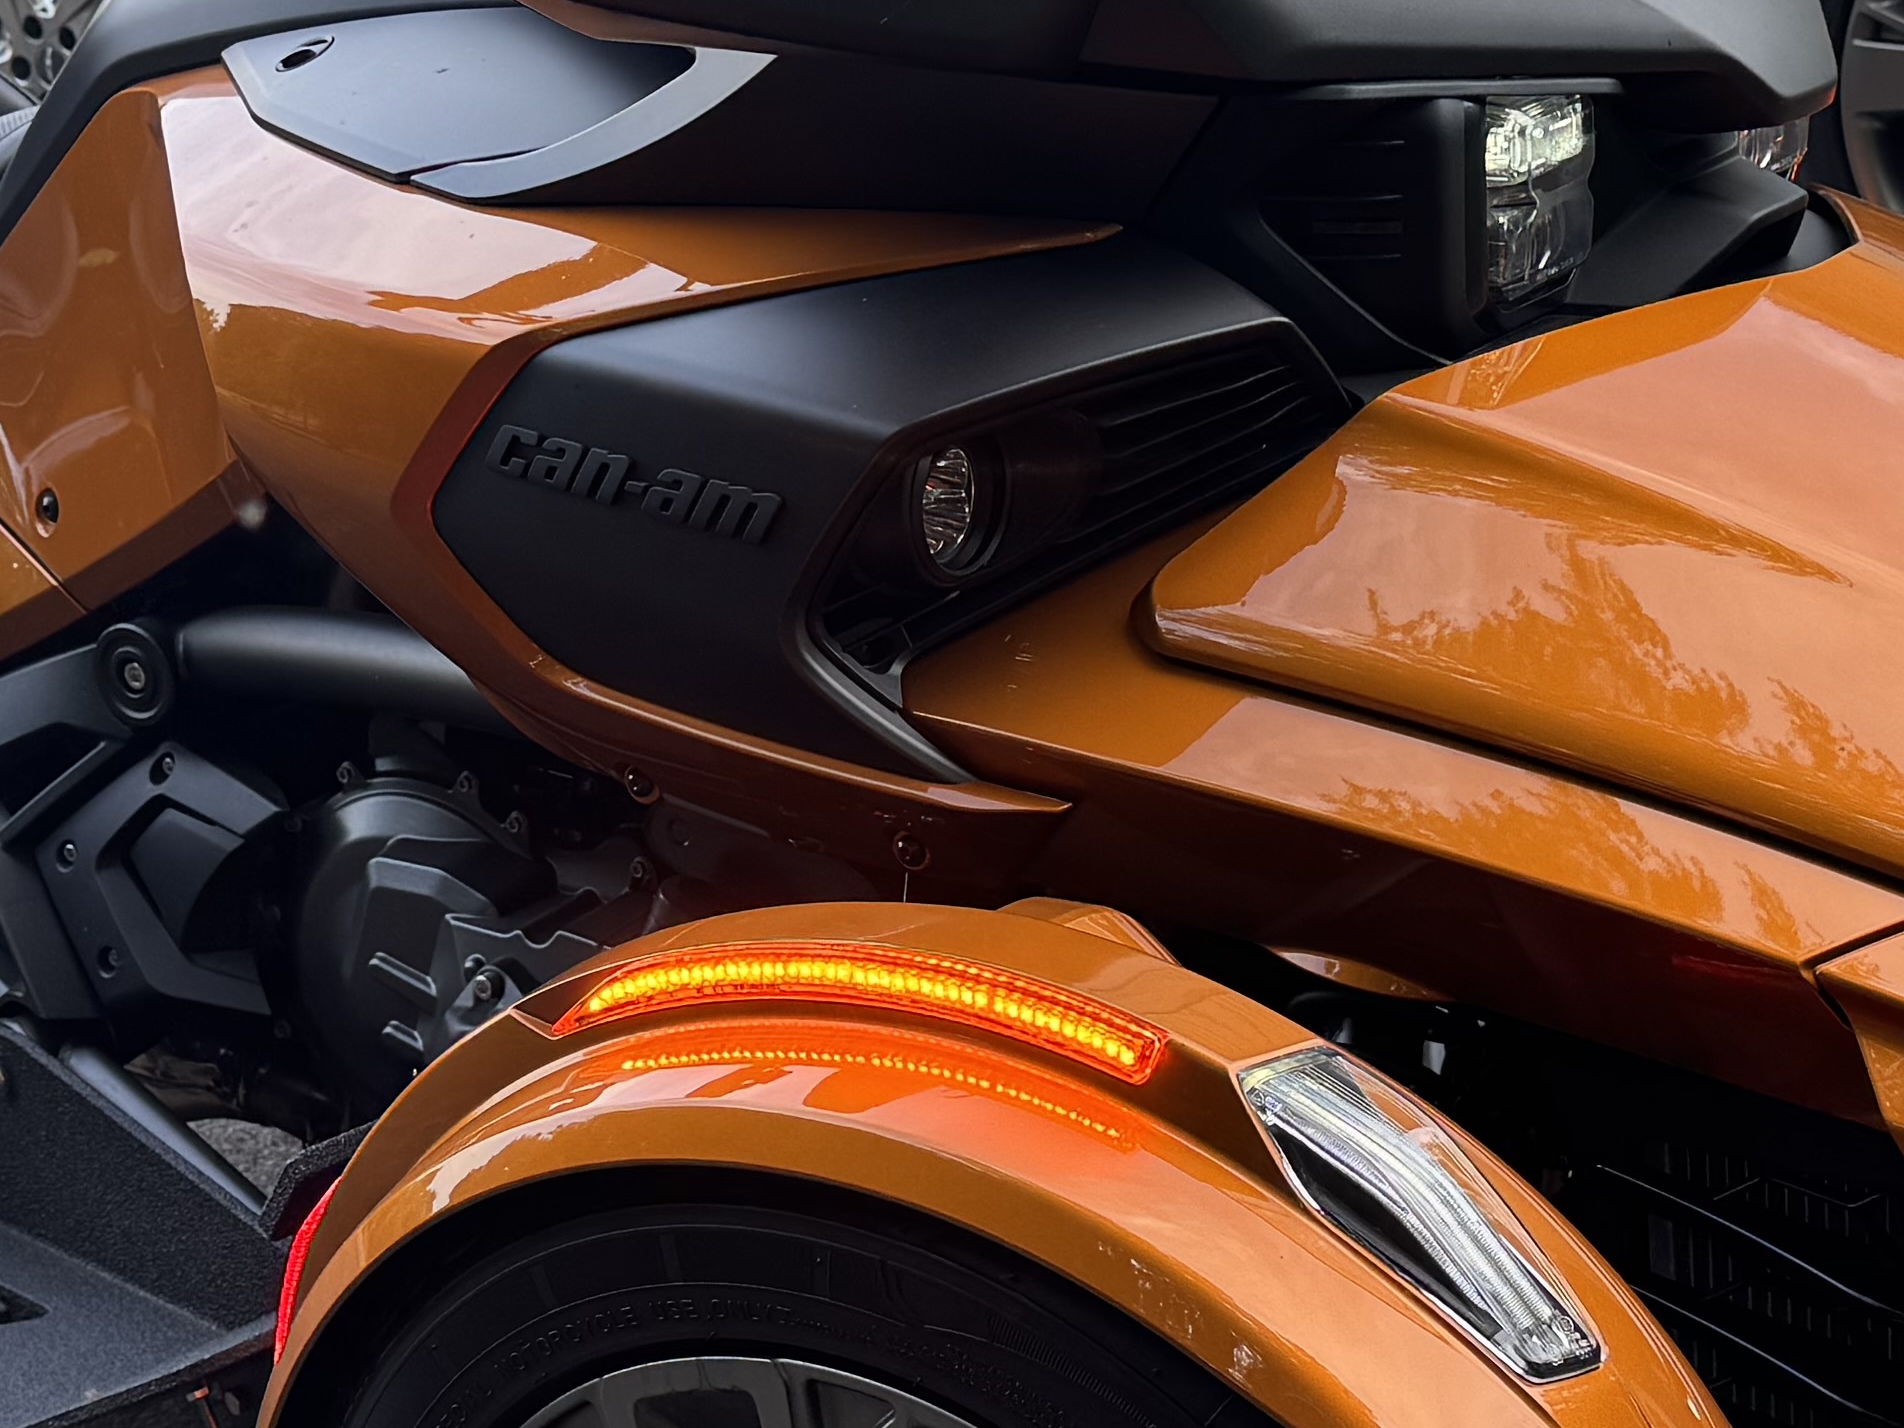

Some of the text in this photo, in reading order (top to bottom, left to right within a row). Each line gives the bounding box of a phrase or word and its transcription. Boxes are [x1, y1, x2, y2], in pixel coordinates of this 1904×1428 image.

[485, 424, 784, 544] can-am
[492, 1303, 638, 1379] MOTORCYCLE
[649, 1299, 698, 1320] USE
[711, 1296, 771, 1322] ONLY
